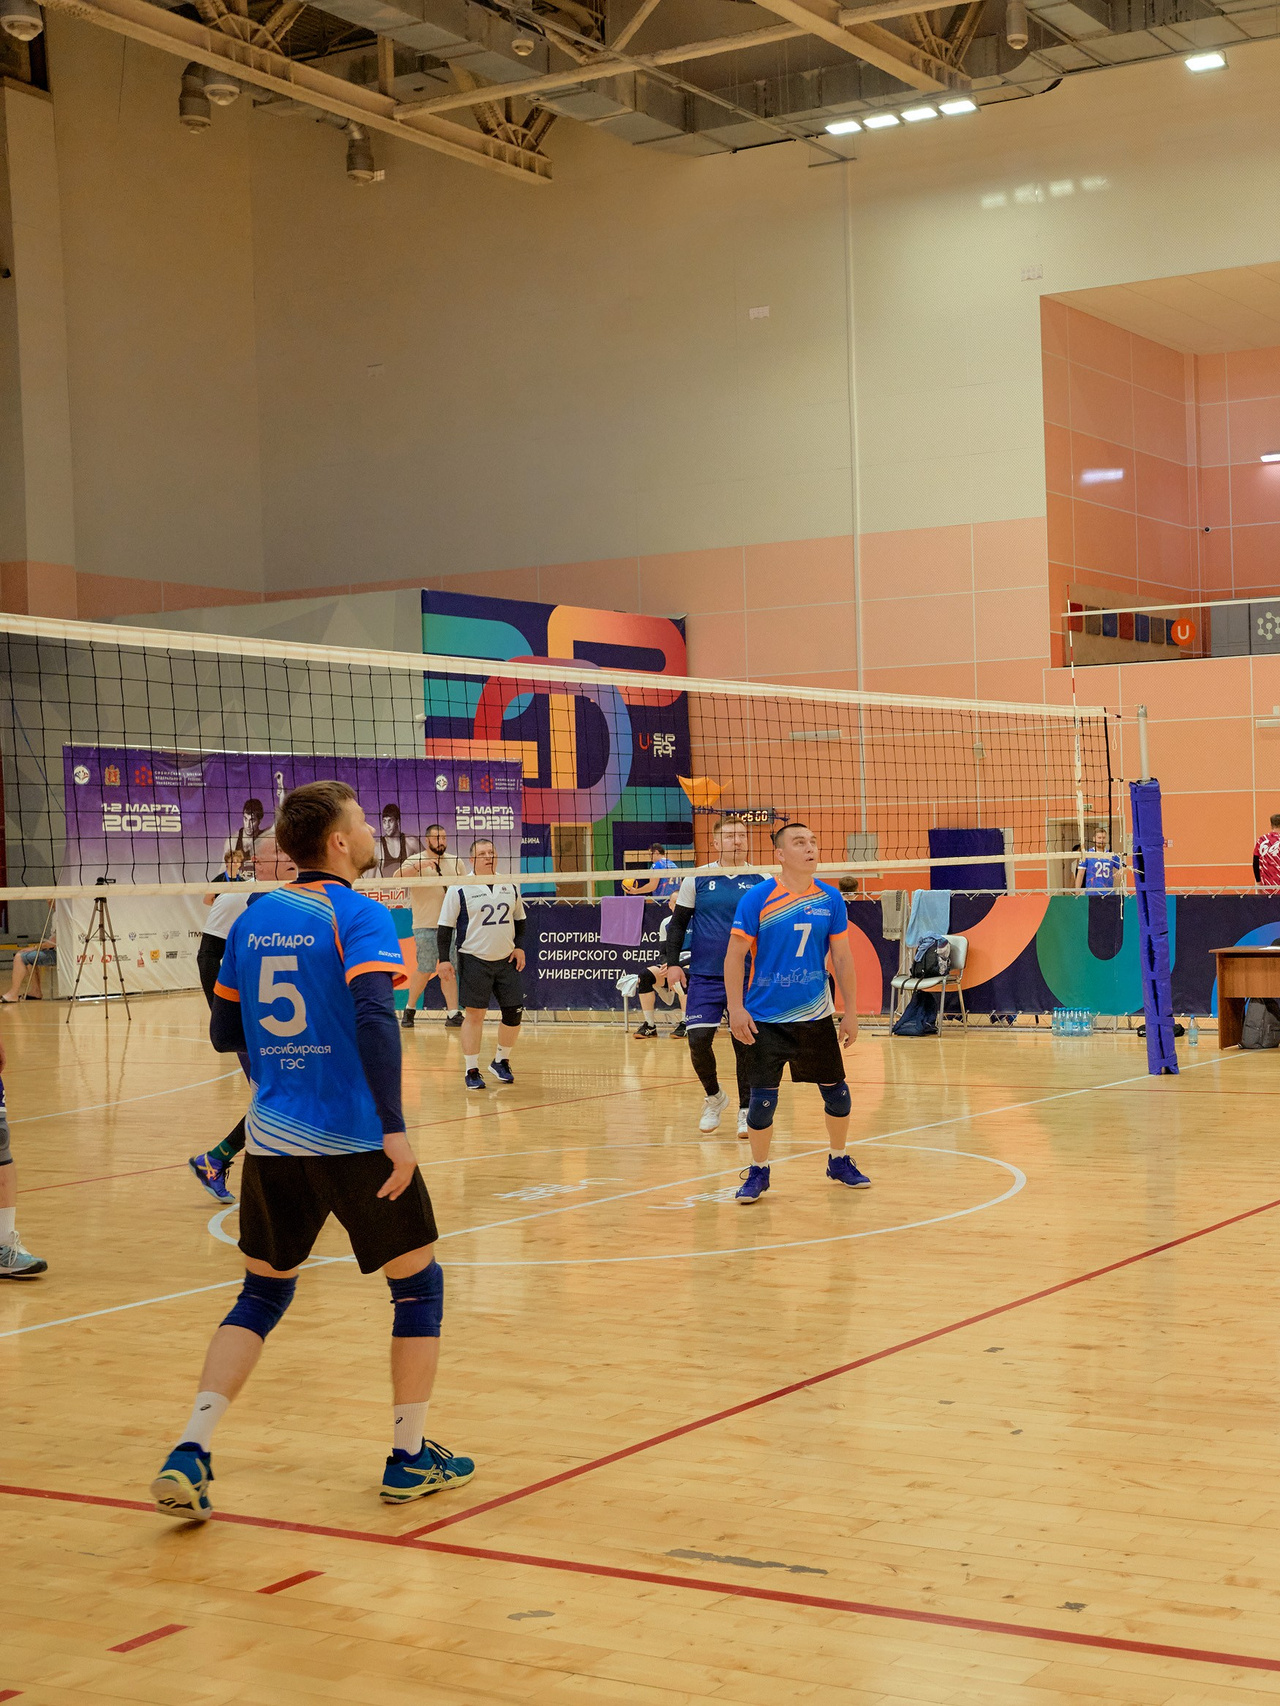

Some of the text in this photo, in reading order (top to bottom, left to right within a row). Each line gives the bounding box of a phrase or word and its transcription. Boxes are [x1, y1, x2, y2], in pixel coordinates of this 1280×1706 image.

[1177, 625, 1190, 639] U
[101, 803, 181, 814] 1-2 МАРТА
[456, 806, 514, 815] 1-2 МАРТА
[102, 815, 181, 832] 2025
[456, 816, 514, 830] 2025
[1259, 840, 1280, 857] 64
[1094, 861, 1110, 878] 25
[708, 880, 716, 890] 8
[480, 902, 510, 926] 22
[247, 933, 315, 950] РусГидро
[539, 931, 601, 943] СПОРТИВН
[793, 923, 812, 958] 7
[538, 950, 661, 962] СИБИРСКОГО ФЕДЕР
[538, 969, 627, 980] УНИВЕРСИТЕТА
[258, 955, 308, 1037] 5
[280, 1058, 305, 1070] ГЭС
